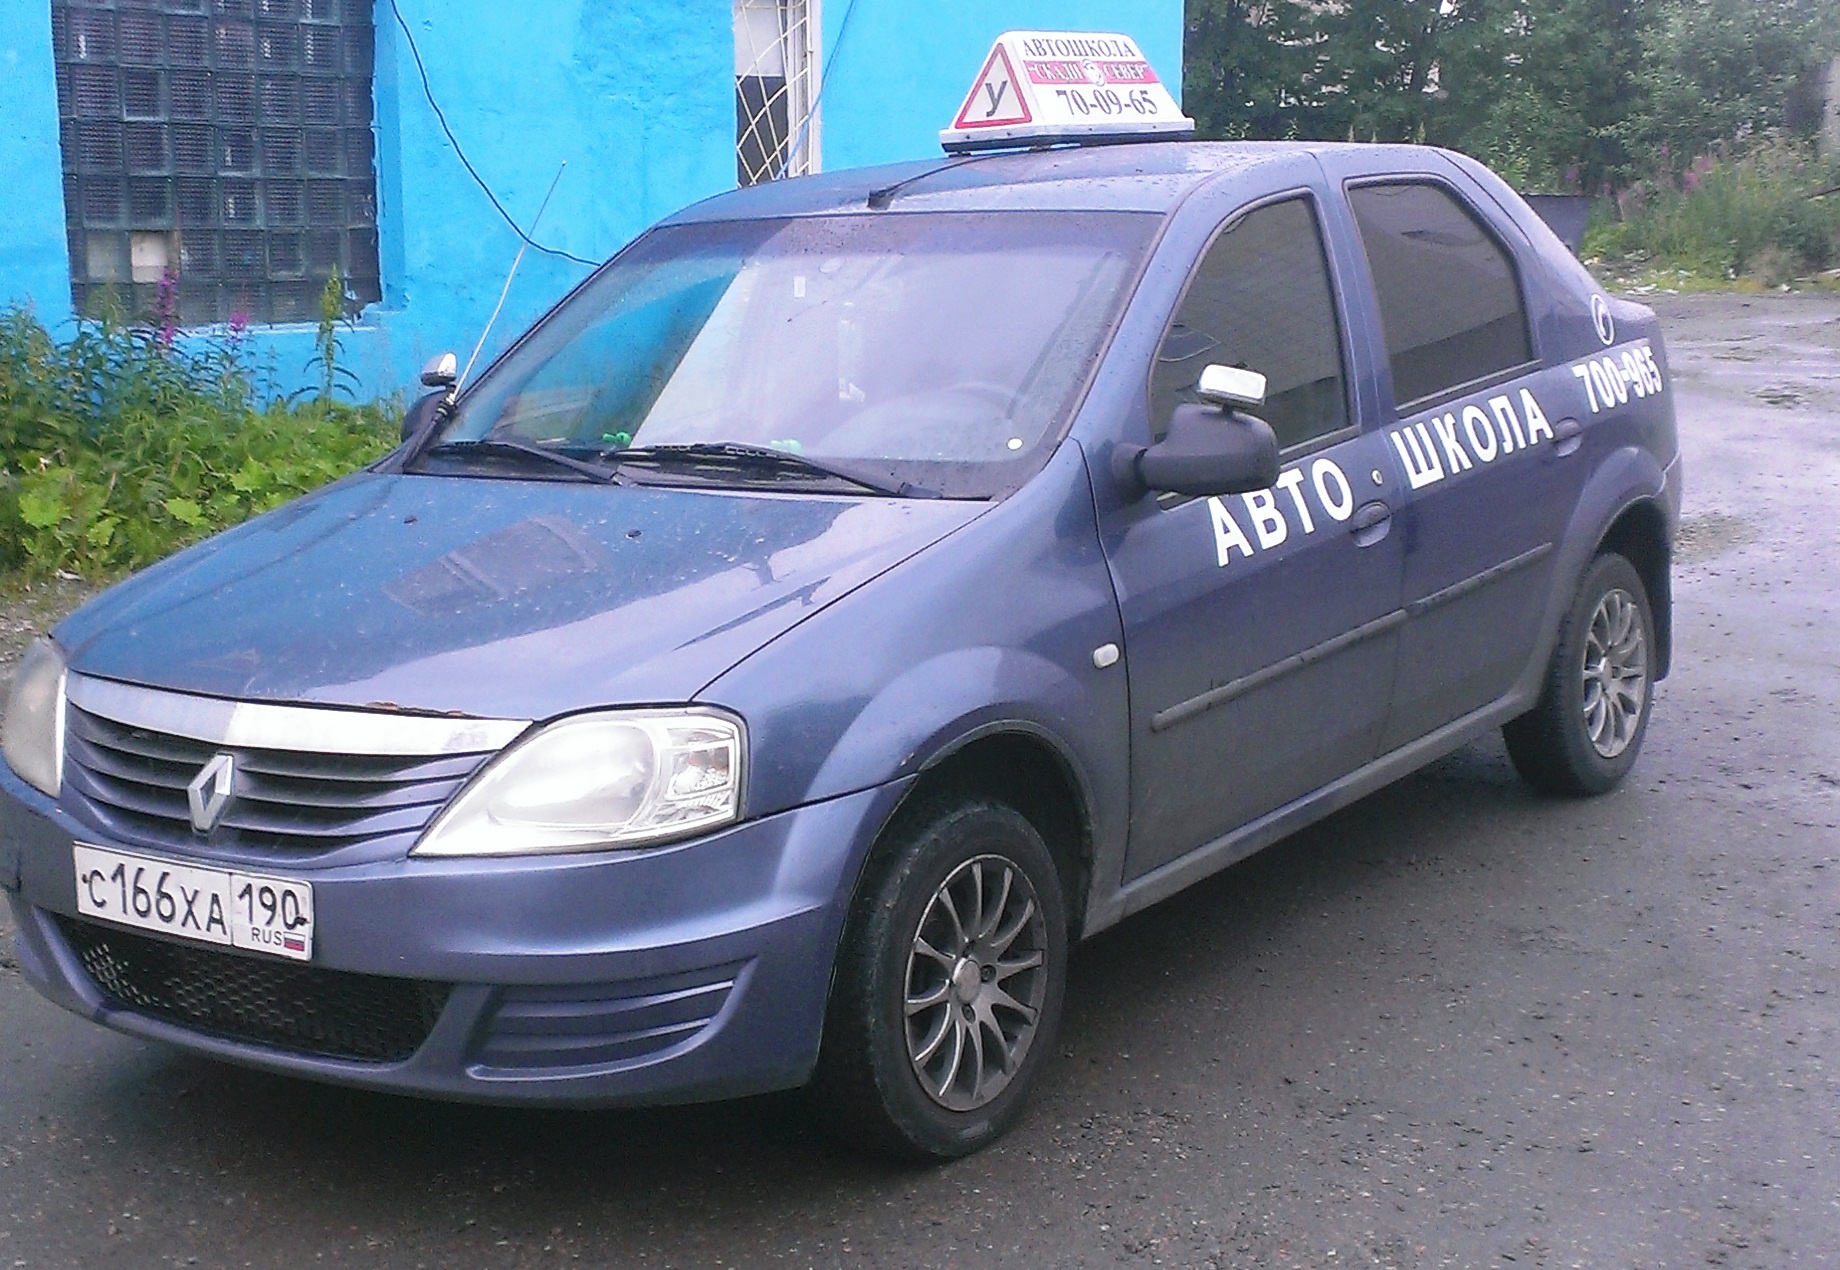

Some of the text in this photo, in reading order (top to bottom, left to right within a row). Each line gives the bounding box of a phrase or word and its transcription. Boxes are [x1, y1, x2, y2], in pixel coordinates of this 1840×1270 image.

[1023, 38, 1136, 58] АВТОШКОЛА
[1056, 89, 1158, 116] 70-09-65
[1571, 346, 1663, 413] 700-965
[1207, 388, 1554, 567] АВТО ШКОЛА
[237, 882, 301, 931] 190
[251, 926, 283, 946] RUS
